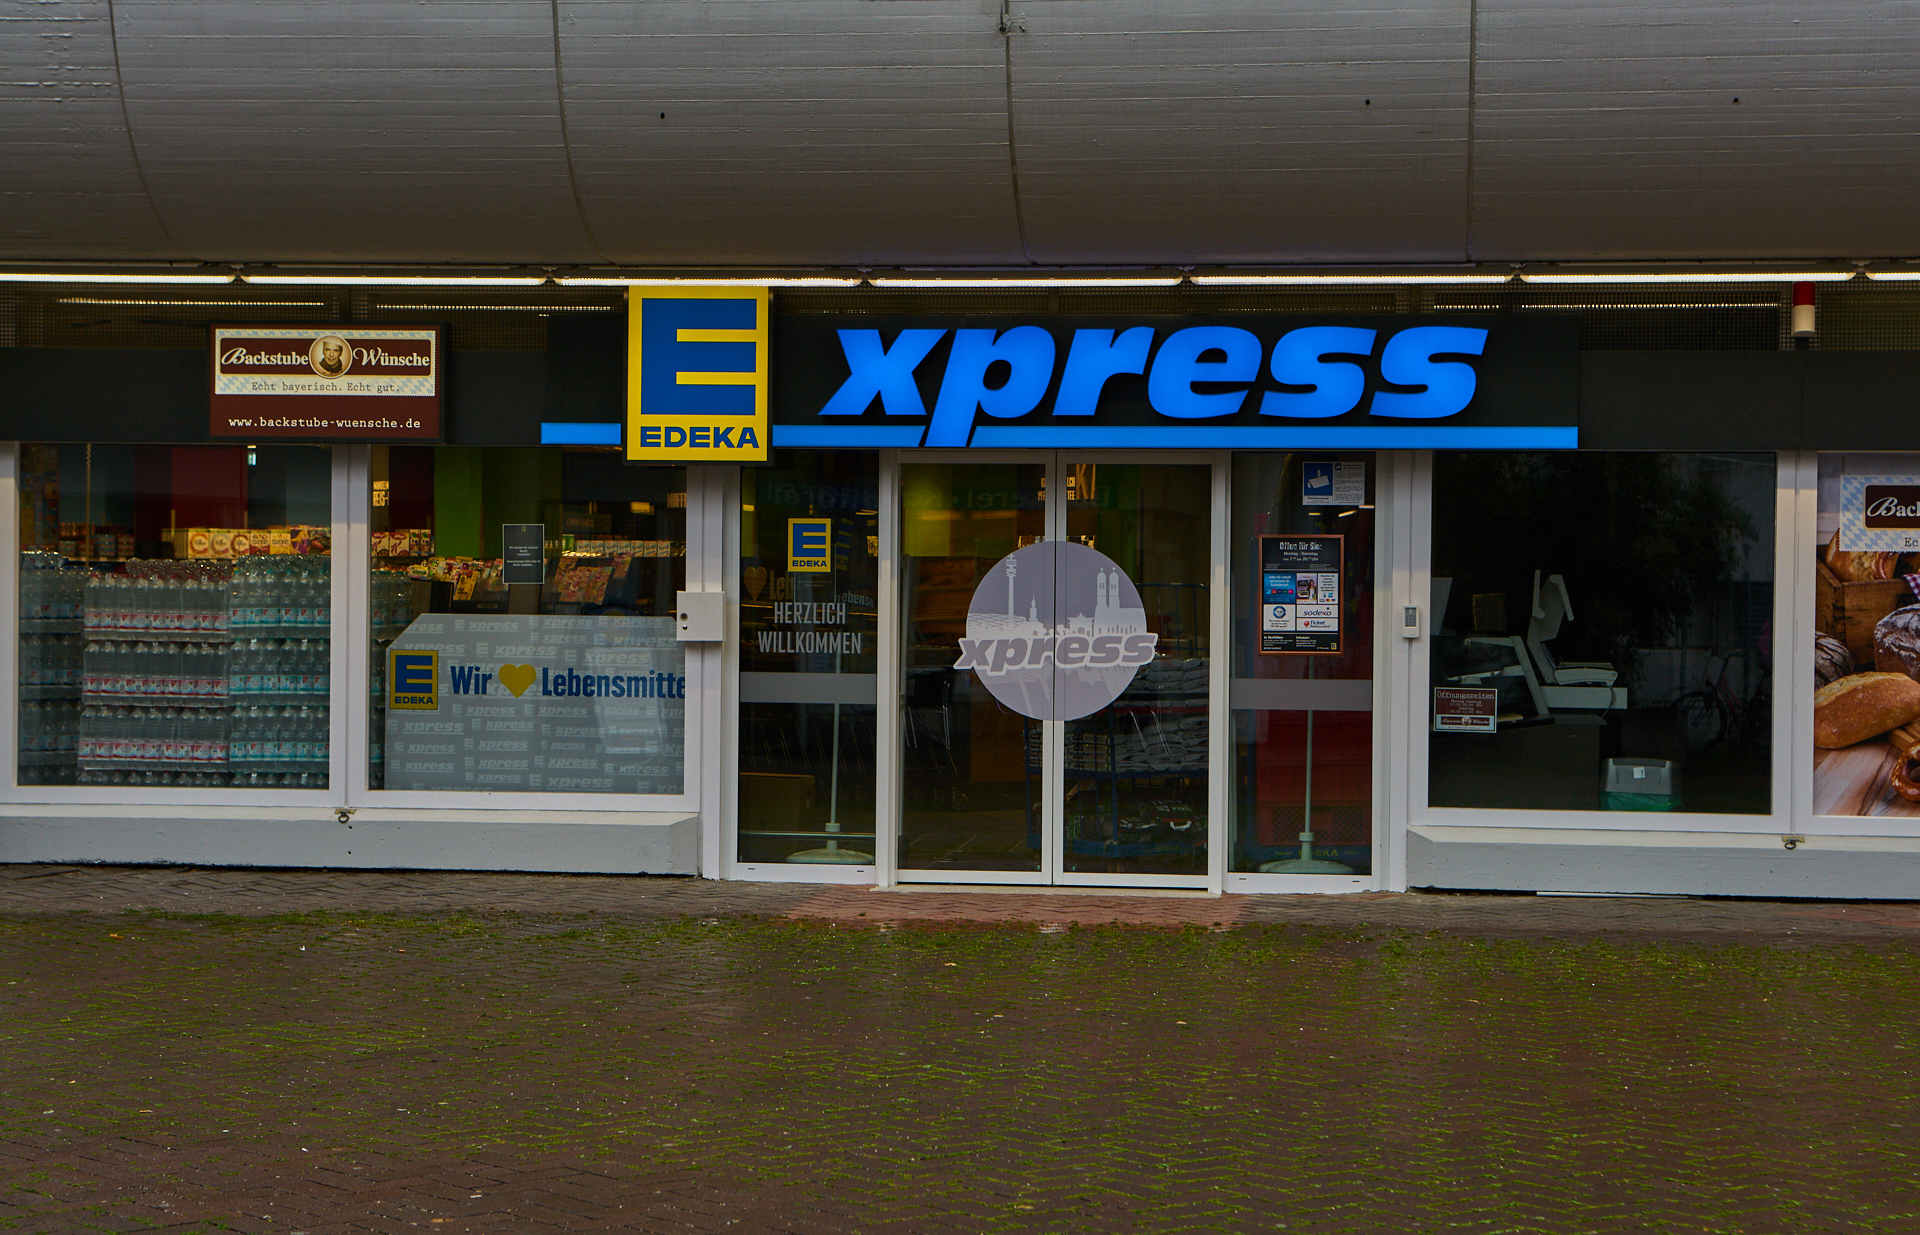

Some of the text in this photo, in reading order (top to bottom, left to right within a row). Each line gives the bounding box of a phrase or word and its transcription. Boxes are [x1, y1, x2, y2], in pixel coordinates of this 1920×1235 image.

[221, 347, 430, 366] Backstube Wünsche
[641, 298, 1489, 447] E xpress
[252, 382, 401, 393] Echt bayerisch. Echt gut.
[228, 417, 421, 429] www.backstube-wuensche.de
[640, 426, 759, 448] EDEKA
[775, 602, 846, 625] HERZLICH
[1304, 608, 1331, 616] sodexo
[758, 631, 861, 654] WILLKOMMEN
[955, 634, 1157, 673] xpress
[451, 666, 492, 695] Wir
[1437, 690, 1494, 699] Öffnungszeiten
